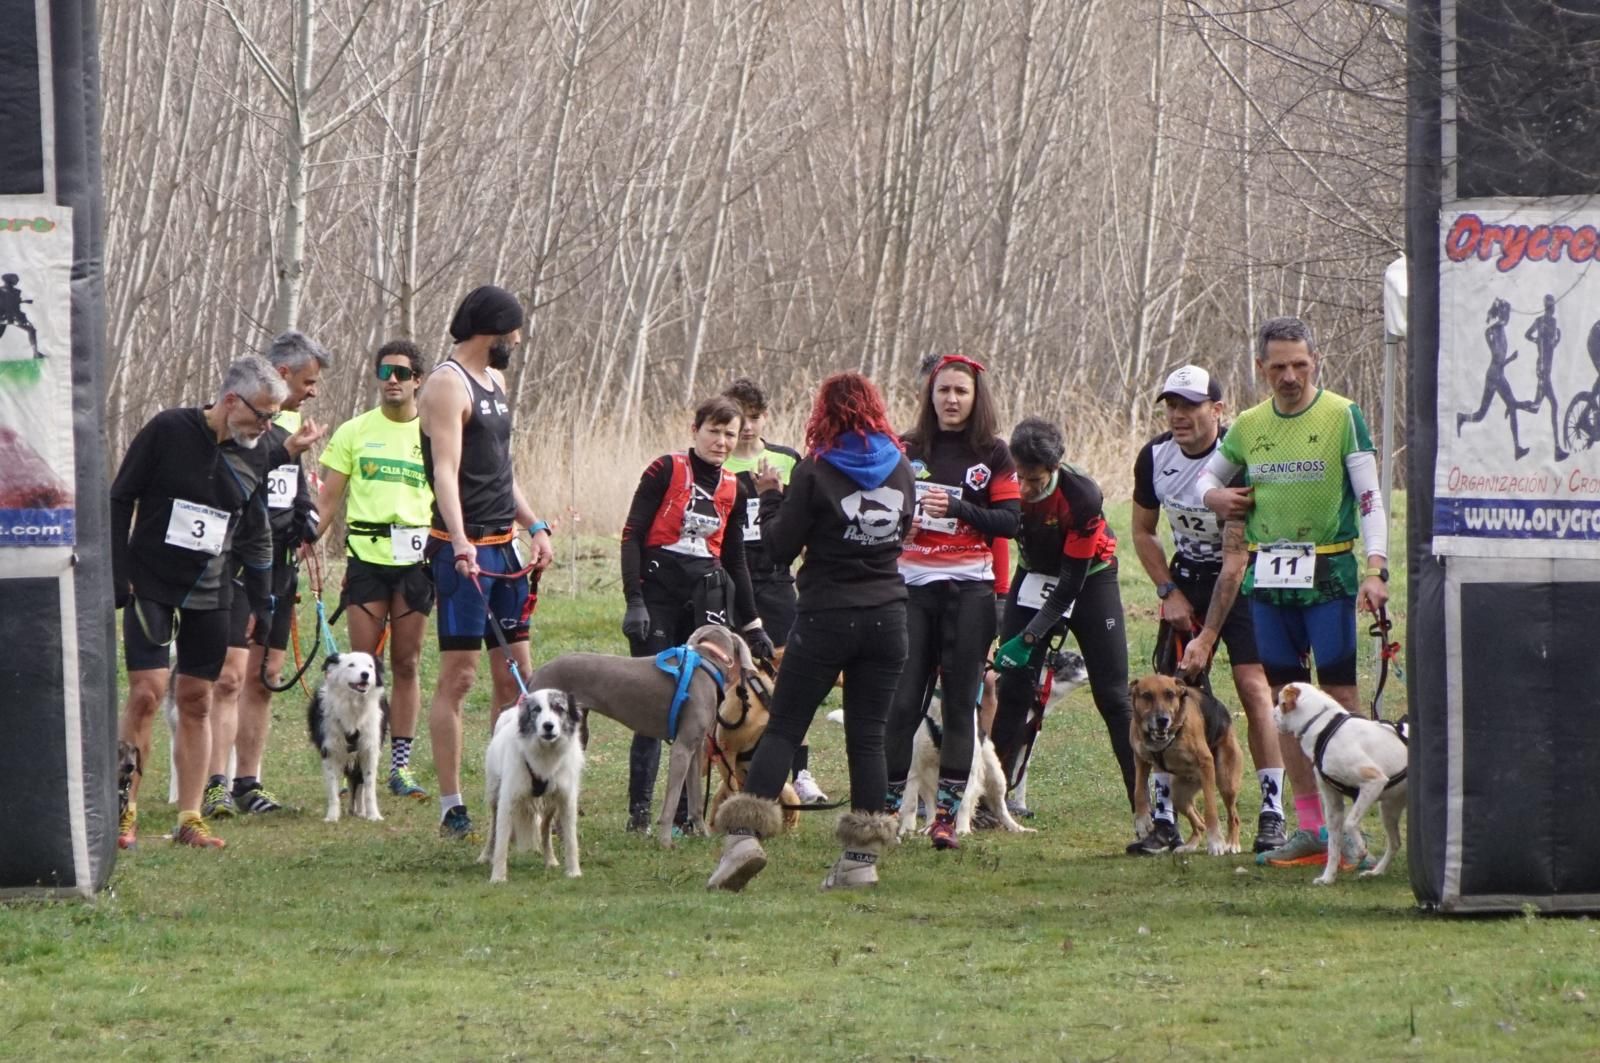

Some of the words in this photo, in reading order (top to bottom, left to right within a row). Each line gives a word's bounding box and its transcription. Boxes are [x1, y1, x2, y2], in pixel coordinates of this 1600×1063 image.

[191, 519, 206, 538] 3
[1178, 515, 1206, 532] 12
[411, 535, 422, 550] 6
[1270, 556, 1298, 575] 11
[1039, 582, 1057, 600] 5
